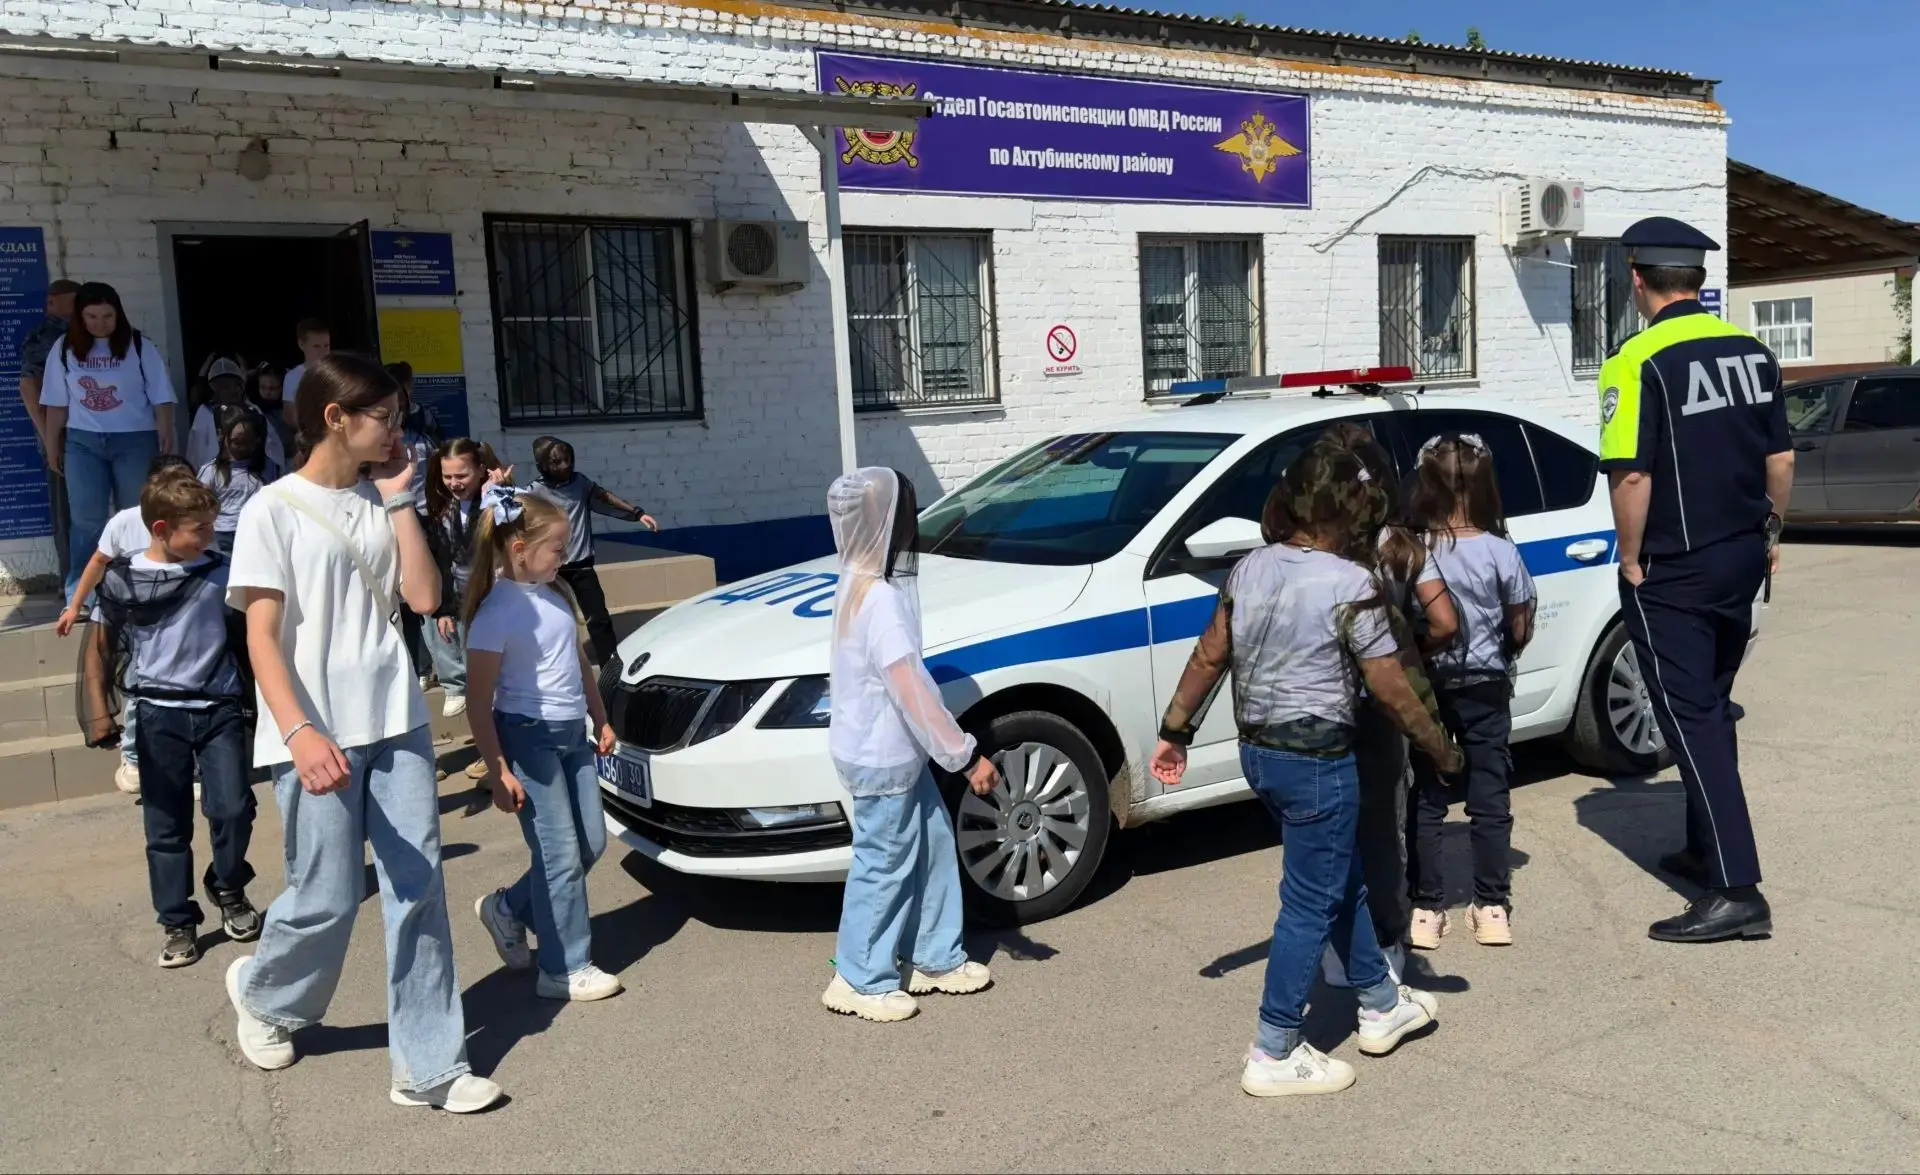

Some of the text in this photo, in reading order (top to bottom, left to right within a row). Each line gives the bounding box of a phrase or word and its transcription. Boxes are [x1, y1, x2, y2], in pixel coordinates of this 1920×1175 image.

[979, 96, 1126, 128] Госавтоинспекции
[1129, 108, 1170, 132] ОМВД
[1172, 111, 1222, 132] России
[990, 146, 1174, 175] по Ахтубинскому району
[1681, 354, 1773, 416] ДПС
[695, 572, 840, 618] ДПС
[628, 762, 642, 786] 30
